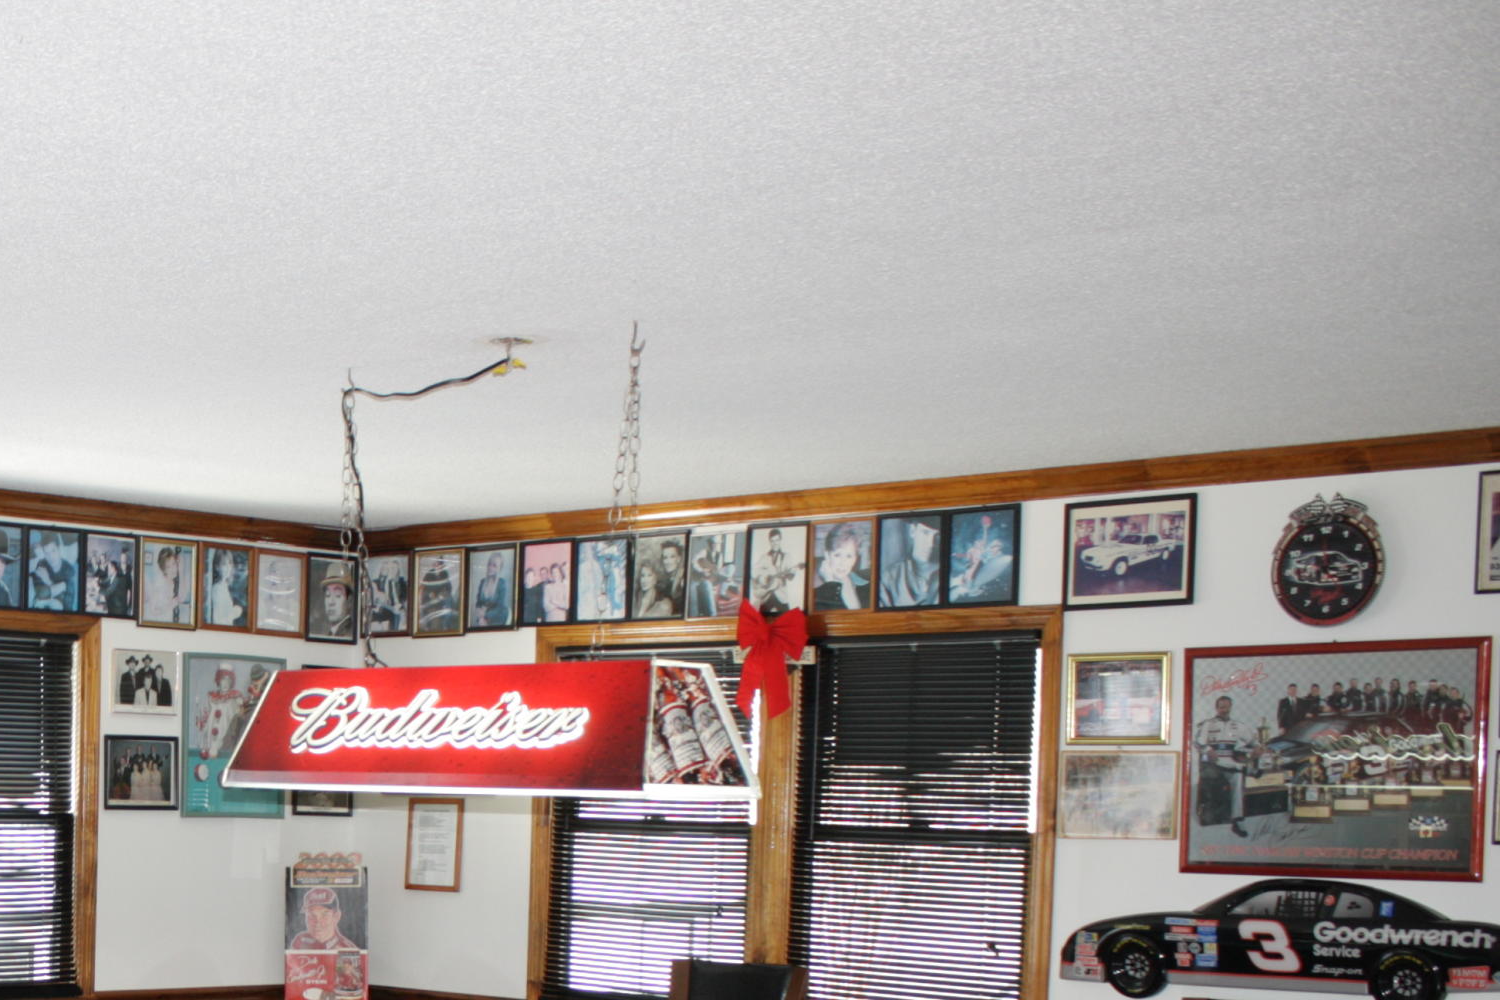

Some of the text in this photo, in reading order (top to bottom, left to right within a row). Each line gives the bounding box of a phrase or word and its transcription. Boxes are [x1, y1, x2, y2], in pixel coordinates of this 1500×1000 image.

[1321, 526, 1332, 534] 12
[1343, 530, 1348, 538] 1
[1354, 543, 1362, 551] 2
[1362, 562, 1369, 570] 3
[1290, 586, 1297, 595] 8
[1355, 582, 1362, 590] 4
[1304, 599, 1311, 607] 7
[1341, 597, 1348, 606] 5
[1322, 605, 1329, 613] 6
[290, 686, 590, 754] Budweiser
[1361, 848, 1388, 860] CUP
[1388, 848, 1460, 862] CHAMPION
[1313, 921, 1494, 949] Goodwrench
[1238, 918, 1302, 973] 3
[1313, 944, 1362, 958] Service
[1312, 964, 1364, 977] Snap-on
